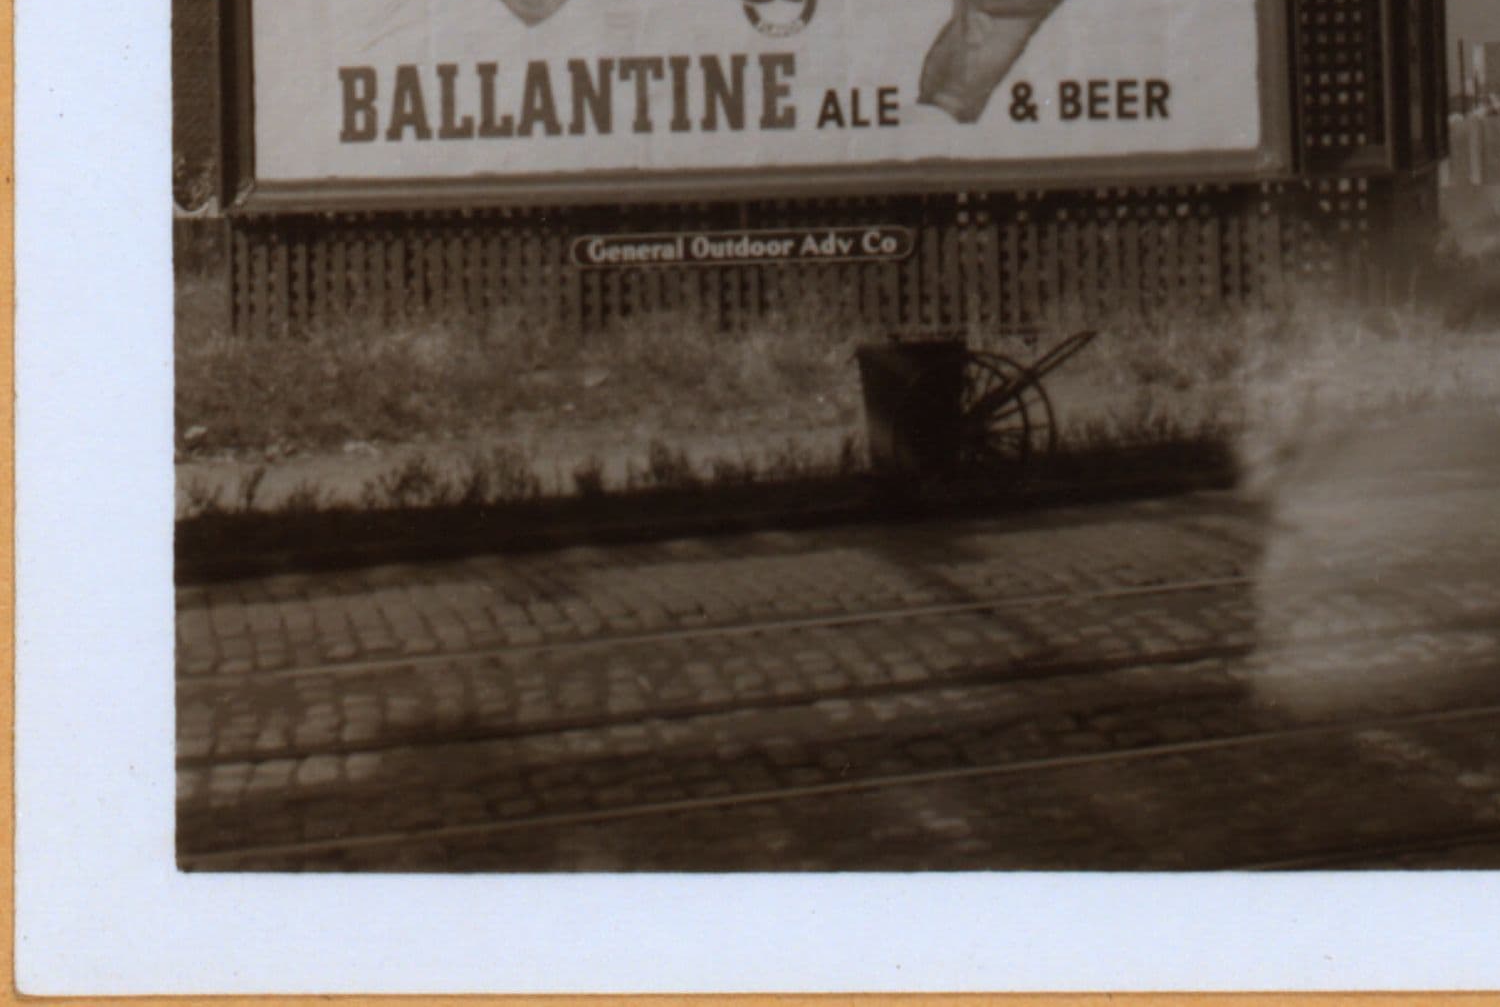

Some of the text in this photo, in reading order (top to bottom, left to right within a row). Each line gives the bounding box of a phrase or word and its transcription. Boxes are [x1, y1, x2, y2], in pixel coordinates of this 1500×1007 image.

[338, 52, 1172, 142] BALLANTINE ALE & BEER
[588, 230, 898, 263] General Outdoor Adv Co
